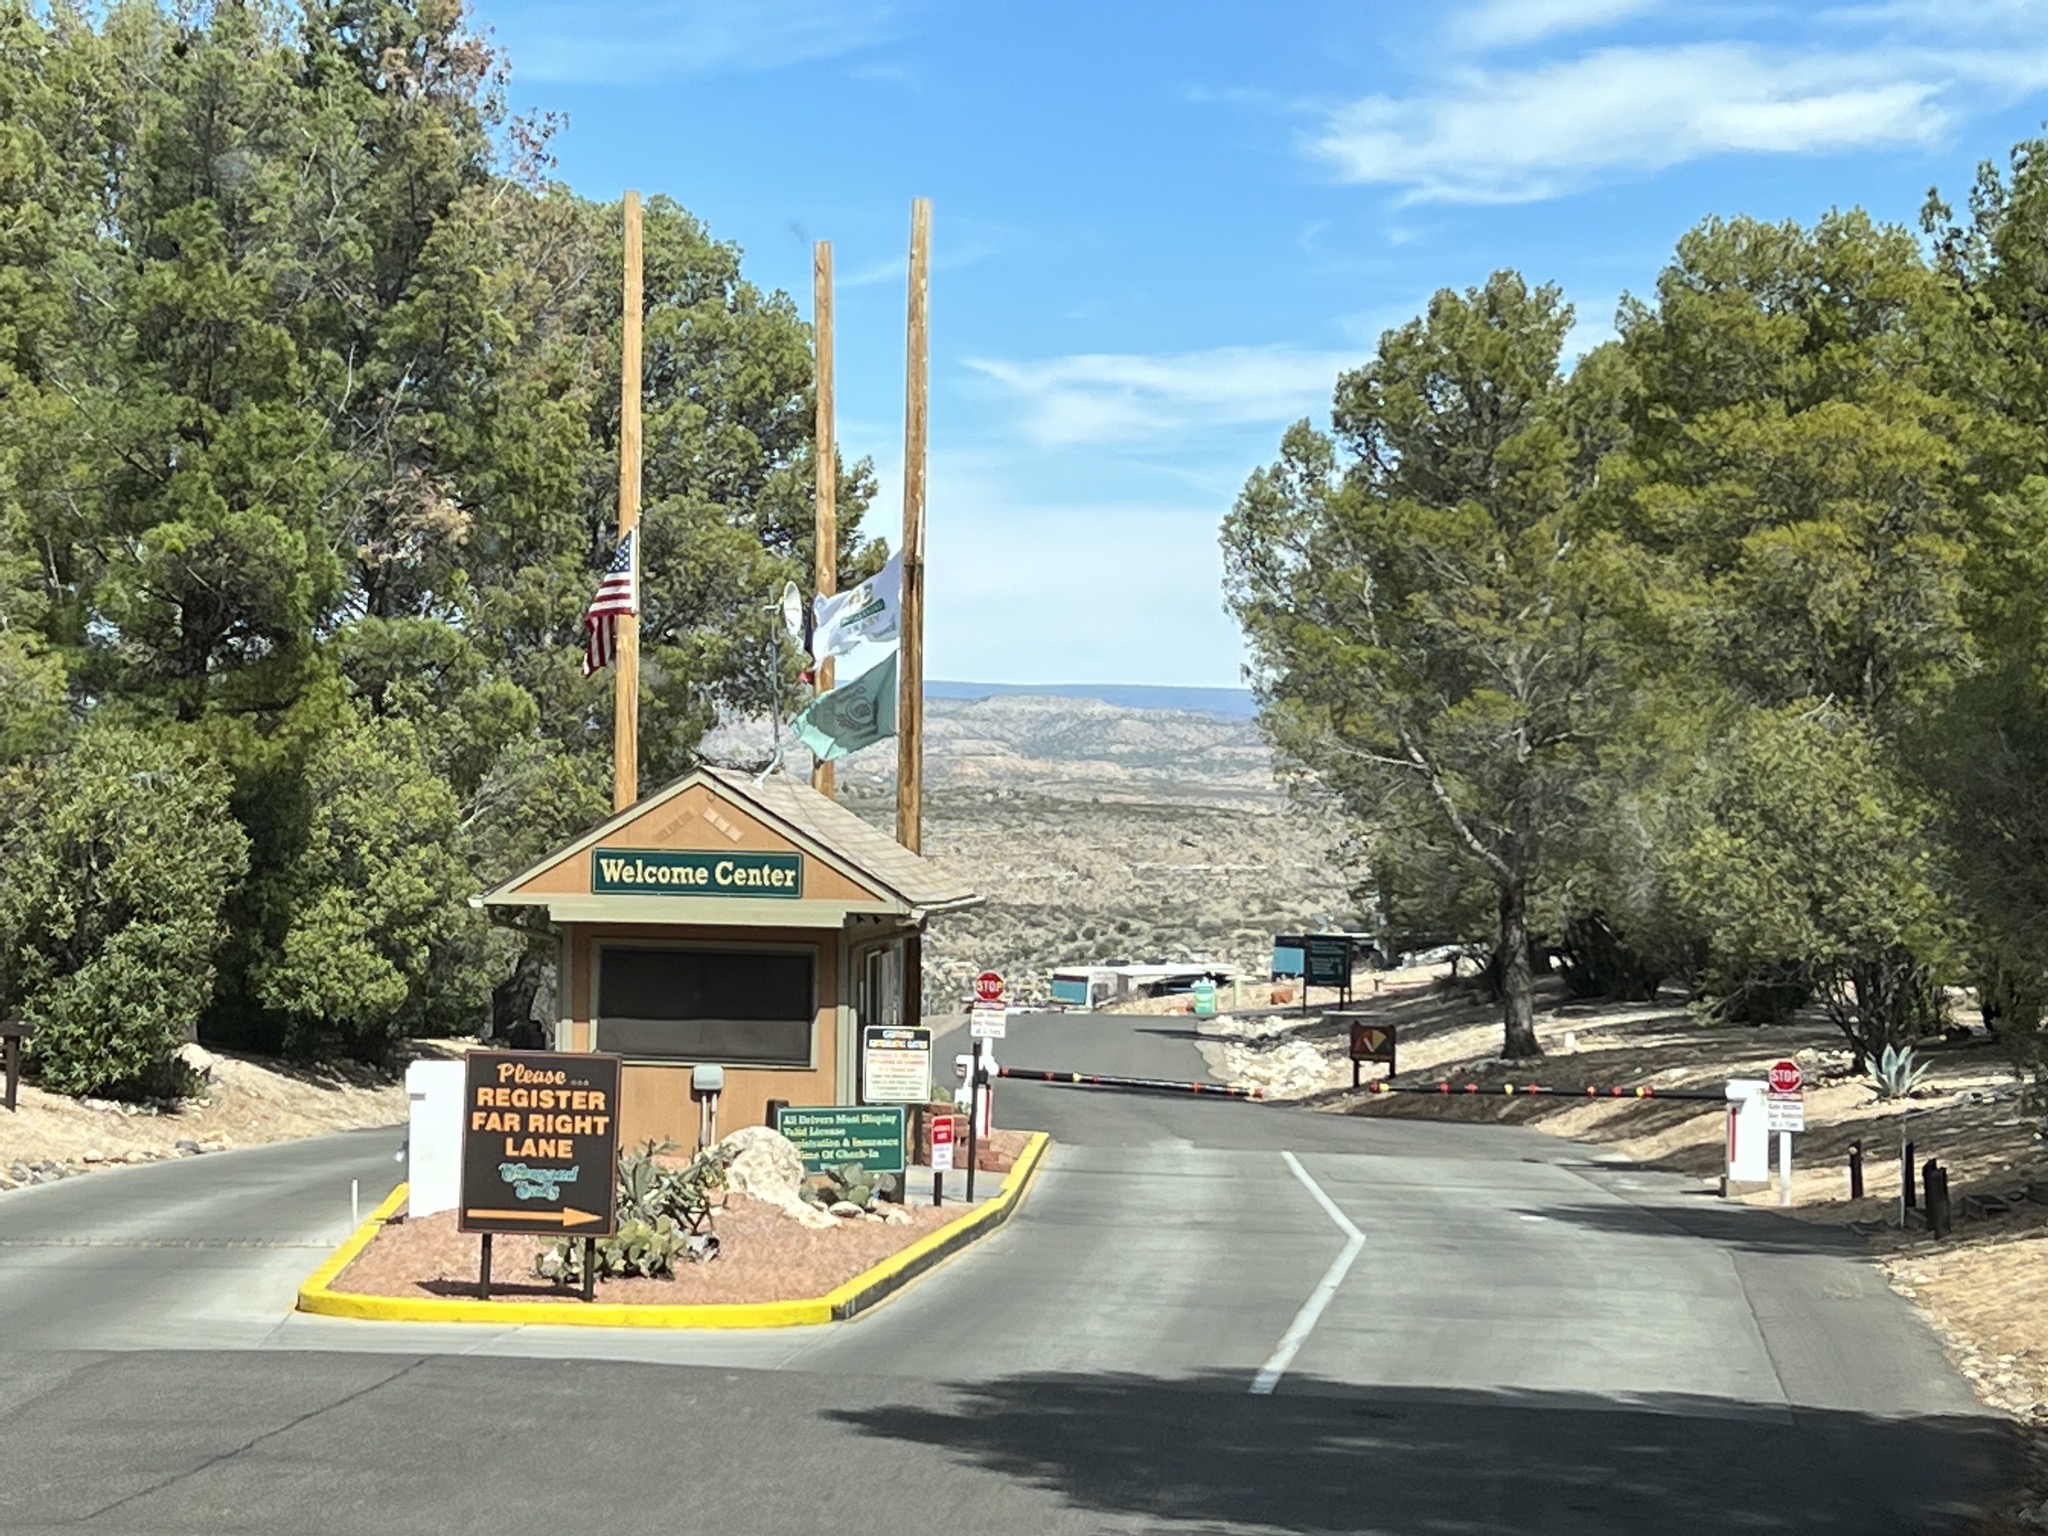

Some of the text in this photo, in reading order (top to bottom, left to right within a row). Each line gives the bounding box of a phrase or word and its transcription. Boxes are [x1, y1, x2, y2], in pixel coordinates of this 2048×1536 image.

[600, 857, 796, 887] Welcome Center
[976, 980, 1004, 993] STOP
[496, 1062, 566, 1085] Please
[1771, 1069, 1800, 1083] STOP
[477, 1087, 606, 1111] REGISTER
[471, 1111, 610, 1135] FAR RIGHT
[783, 1114, 897, 1127] All Drivers Must Display
[783, 1127, 846, 1137] Valid License
[505, 1137, 574, 1159] LANE
[792, 1138, 841, 1149] gistration
[835, 1148, 880, 1160] Check-In
